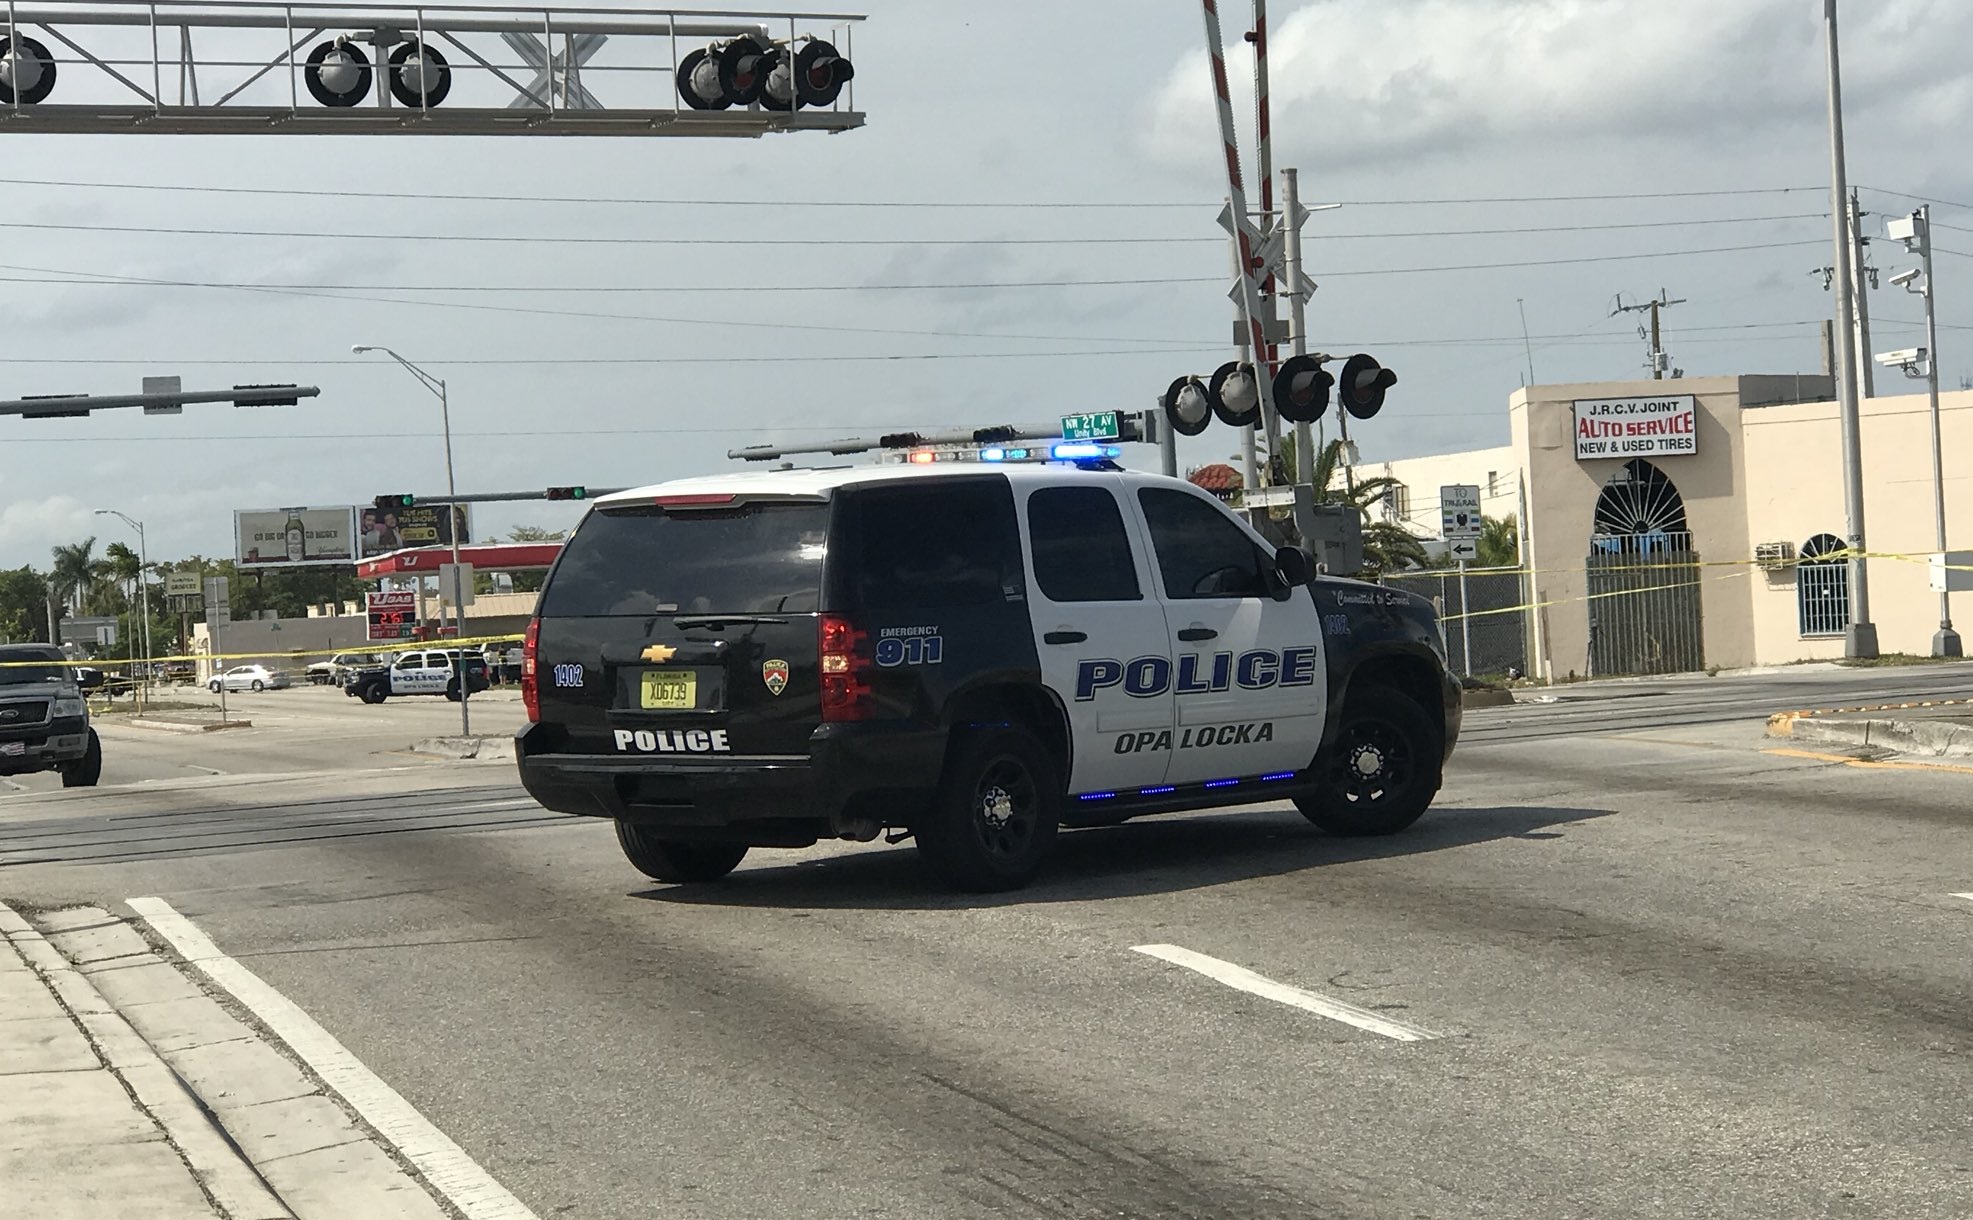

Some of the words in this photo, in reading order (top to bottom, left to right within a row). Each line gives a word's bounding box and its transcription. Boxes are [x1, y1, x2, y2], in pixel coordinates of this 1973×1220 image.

[1589, 403, 1639, 416] J.R.C.V.
[1640, 401, 1679, 413] JOINT
[1066, 418, 1078, 429] NW
[1082, 415, 1095, 428] 27
[1101, 415, 1112, 426] AV
[1578, 417, 1623, 438] AUTO
[1626, 411, 1693, 436] SERVICE
[1093, 427, 1107, 436] Blvd
[1580, 442, 1607, 454] NEW
[1610, 442, 1619, 453] &
[1622, 440, 1655, 452] USED
[1657, 438, 1692, 450] TIRES
[1454, 487, 1468, 498] TO
[880, 626, 939, 637] EMERGENCY
[876, 636, 943, 667] 911
[392, 674, 447, 682] POLICE
[554, 664, 584, 687] 1402
[1075, 645, 1317, 702] POLICE
[613, 729, 731, 752] POLICE
[1114, 731, 1172, 754] OPA
[1180, 722, 1273, 749] LOCKA
